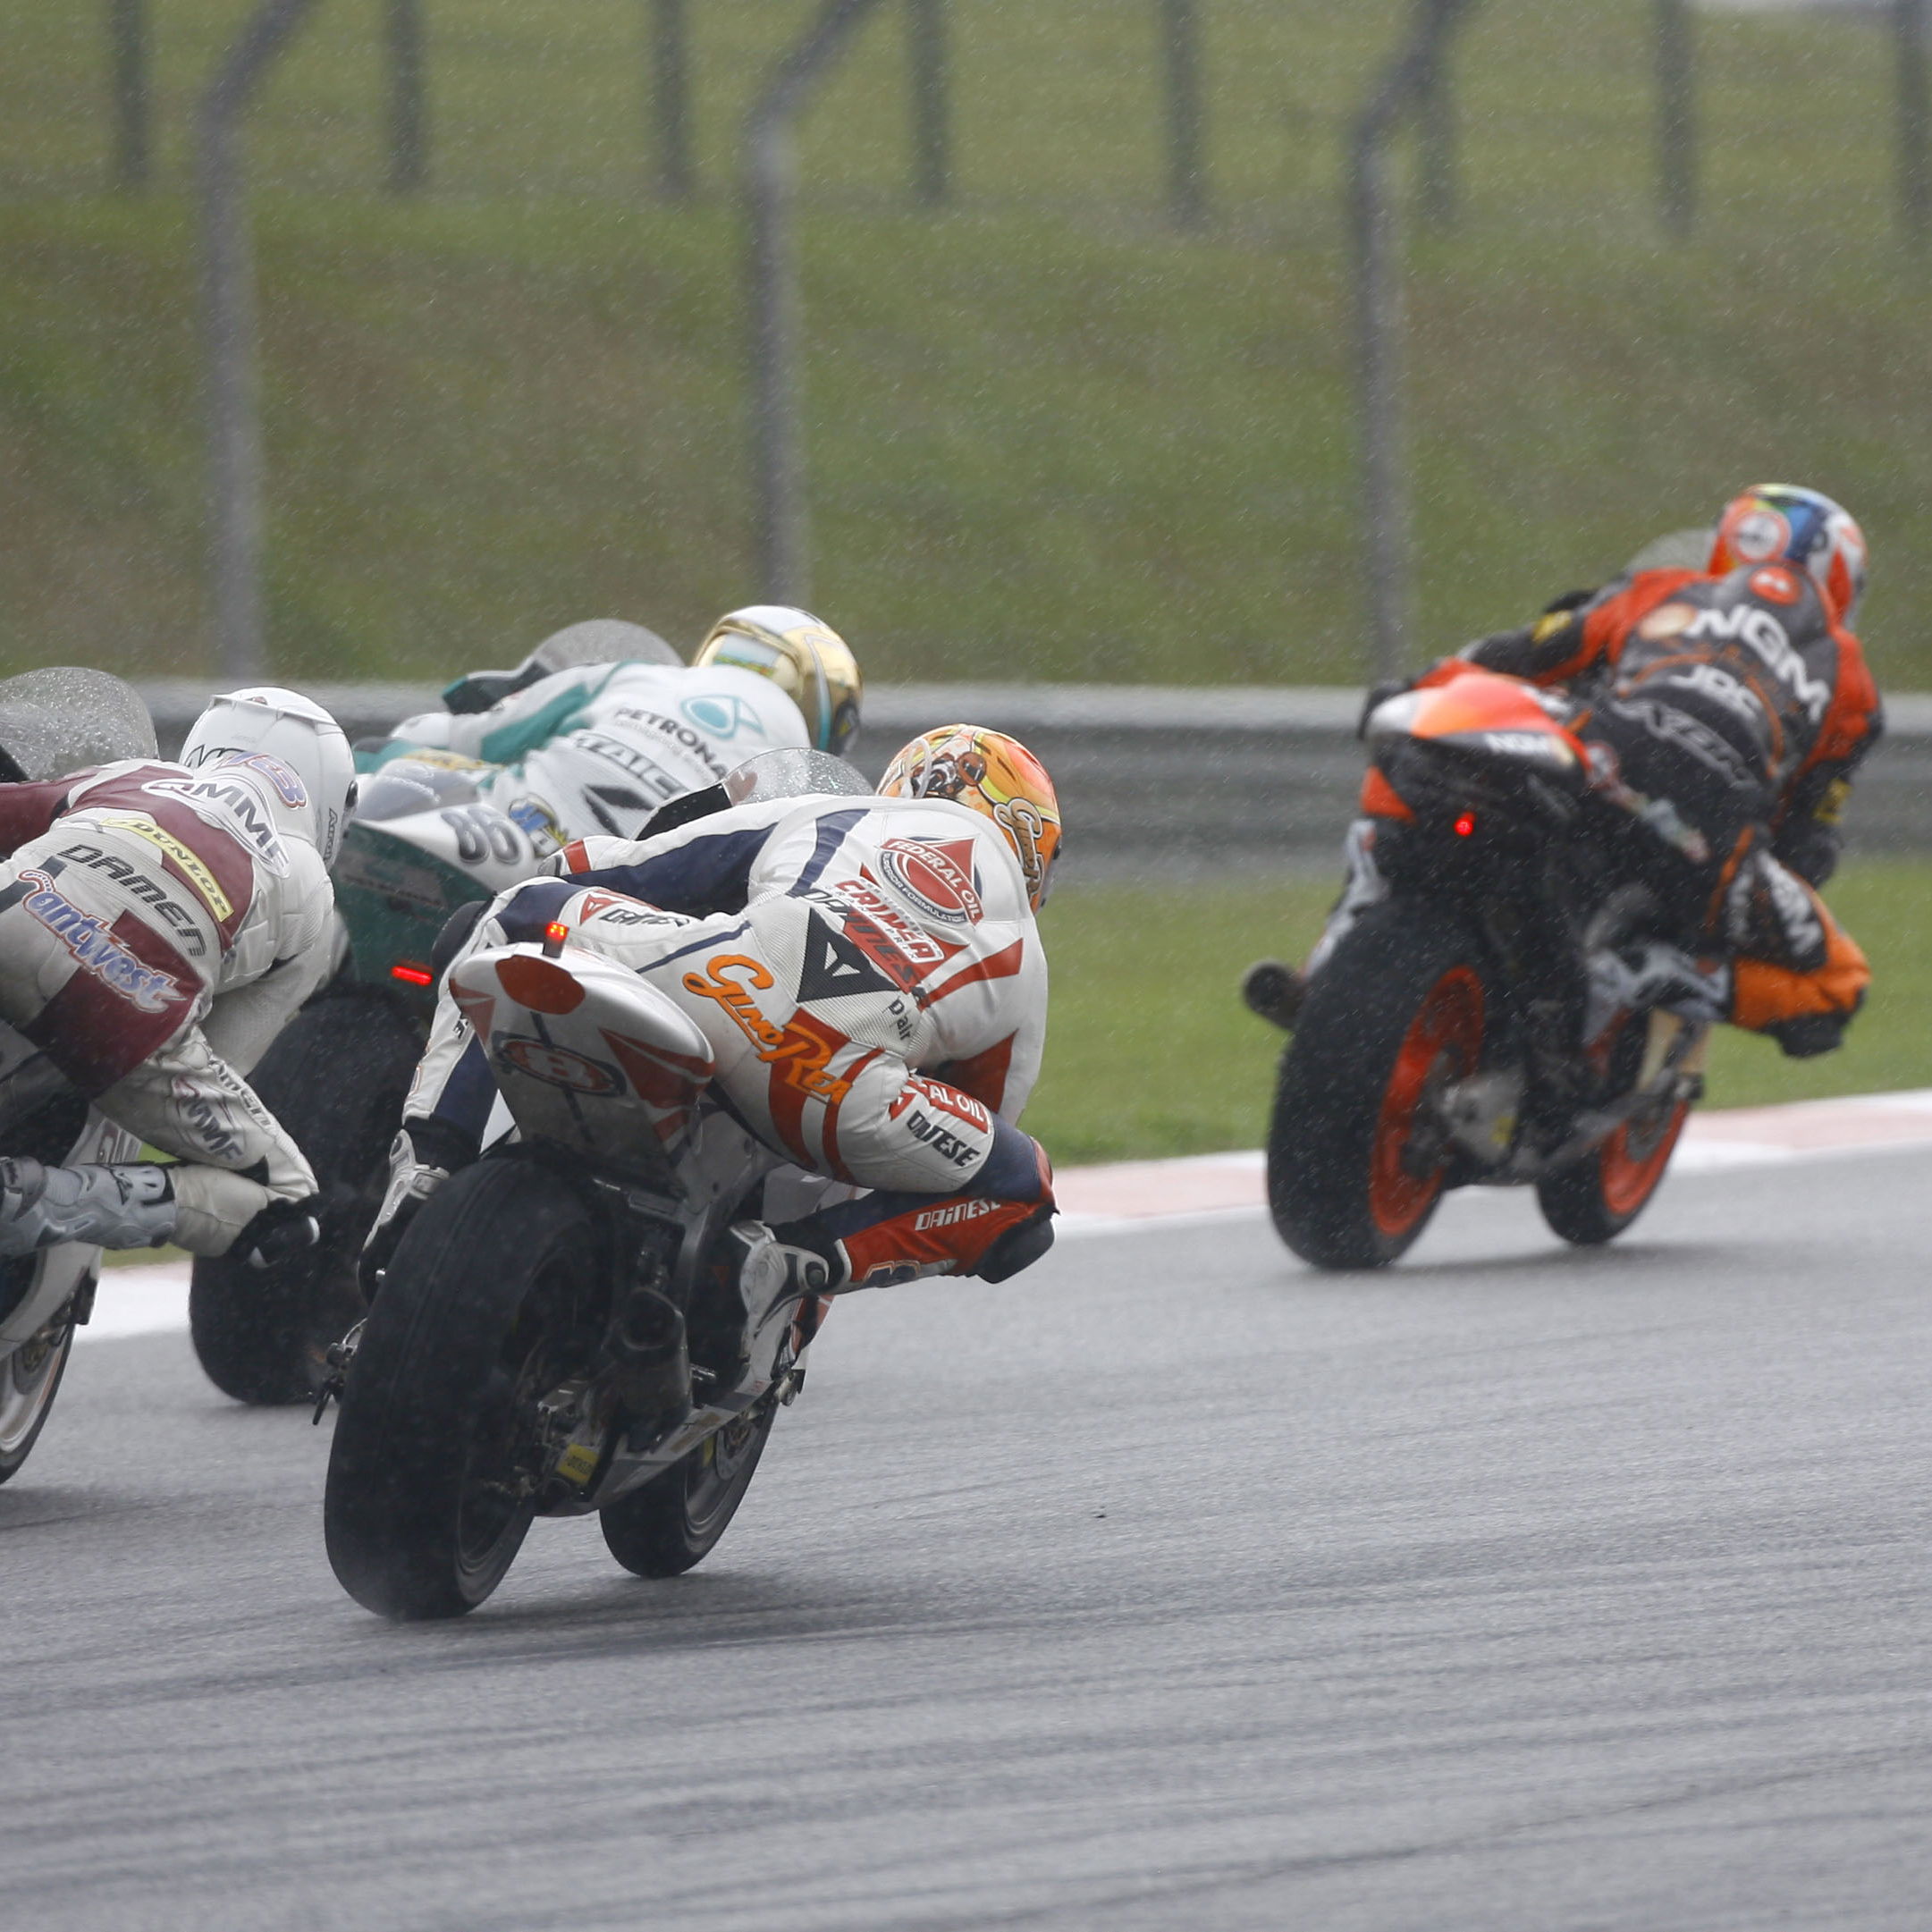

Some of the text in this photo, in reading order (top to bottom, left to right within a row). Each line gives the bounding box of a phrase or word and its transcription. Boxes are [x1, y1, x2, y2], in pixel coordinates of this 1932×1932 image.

[1683, 604, 1830, 723] NGM
[614, 707, 730, 780] PETRONA
[57, 843, 207, 958] DAMEN
[132, 821, 231, 916] DUNLOP
[887, 840, 963, 888] FEDERAL
[961, 889, 981, 919] OIL
[956, 1093, 985, 1123] OIL
